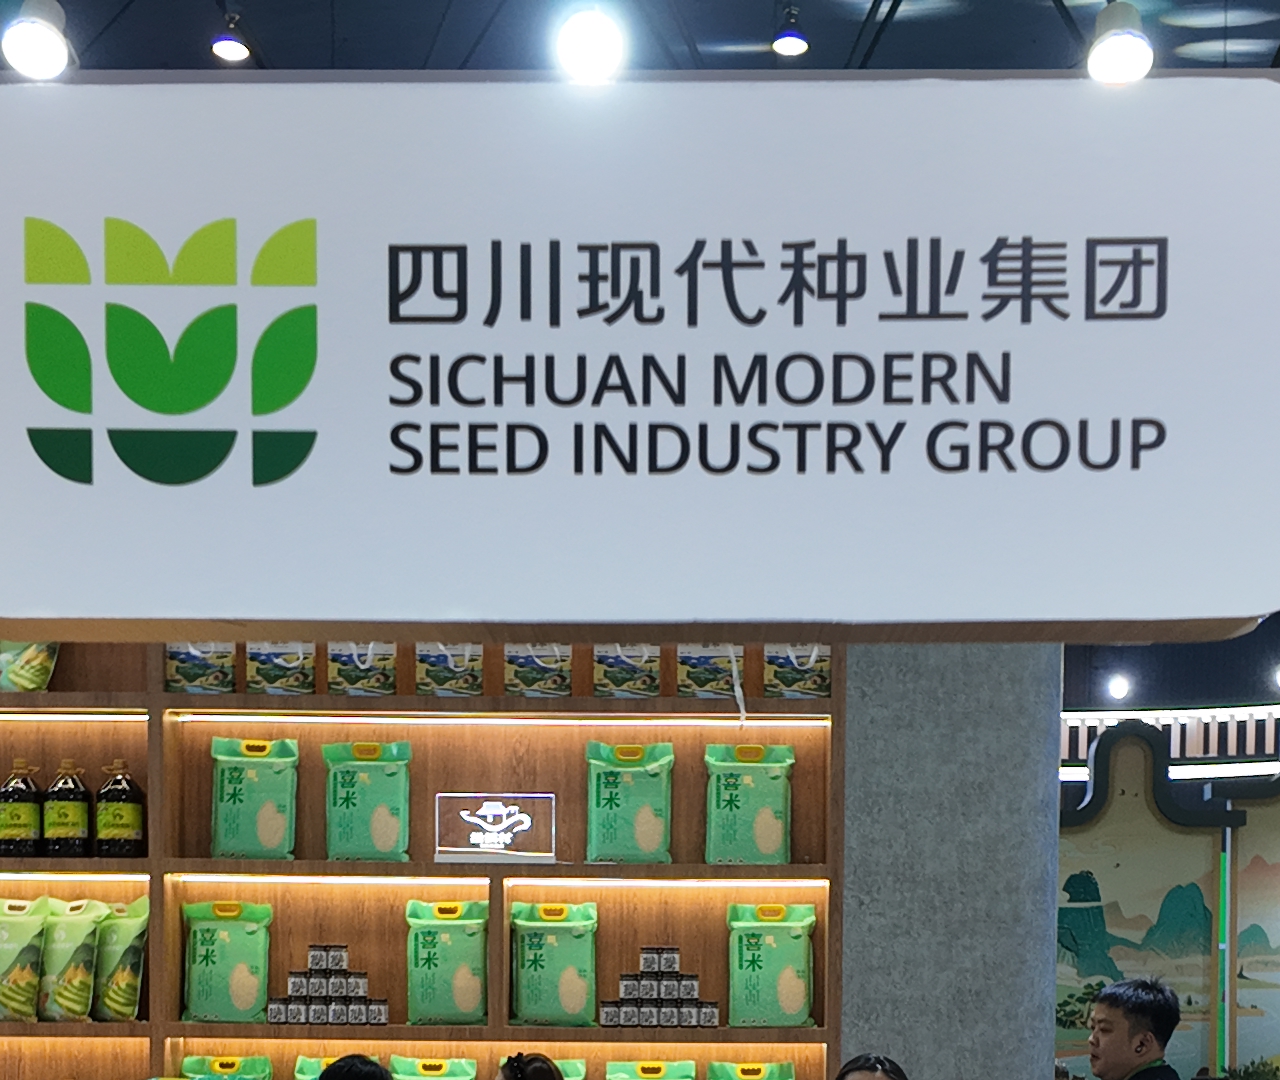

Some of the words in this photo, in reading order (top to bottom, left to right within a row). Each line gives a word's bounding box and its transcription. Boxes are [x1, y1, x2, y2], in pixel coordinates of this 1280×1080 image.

[389, 237, 1167, 327] 四川现代种业集团
[390, 354, 685, 406] SICHUAN
[714, 353, 1010, 405] MODERN
[390, 423, 548, 474] SEED
[574, 422, 906, 474] INDUSTRY
[927, 419, 1165, 472] GROUP
[226, 766, 246, 805] 喜米
[338, 769, 358, 809] 喜米
[601, 770, 621, 810] 喜米
[722, 772, 742, 812] 喜米
[198, 927, 218, 968] 喜米
[419, 929, 439, 970] 喜米
[525, 931, 546, 972] 喜米
[744, 932, 764, 973] 喜米
